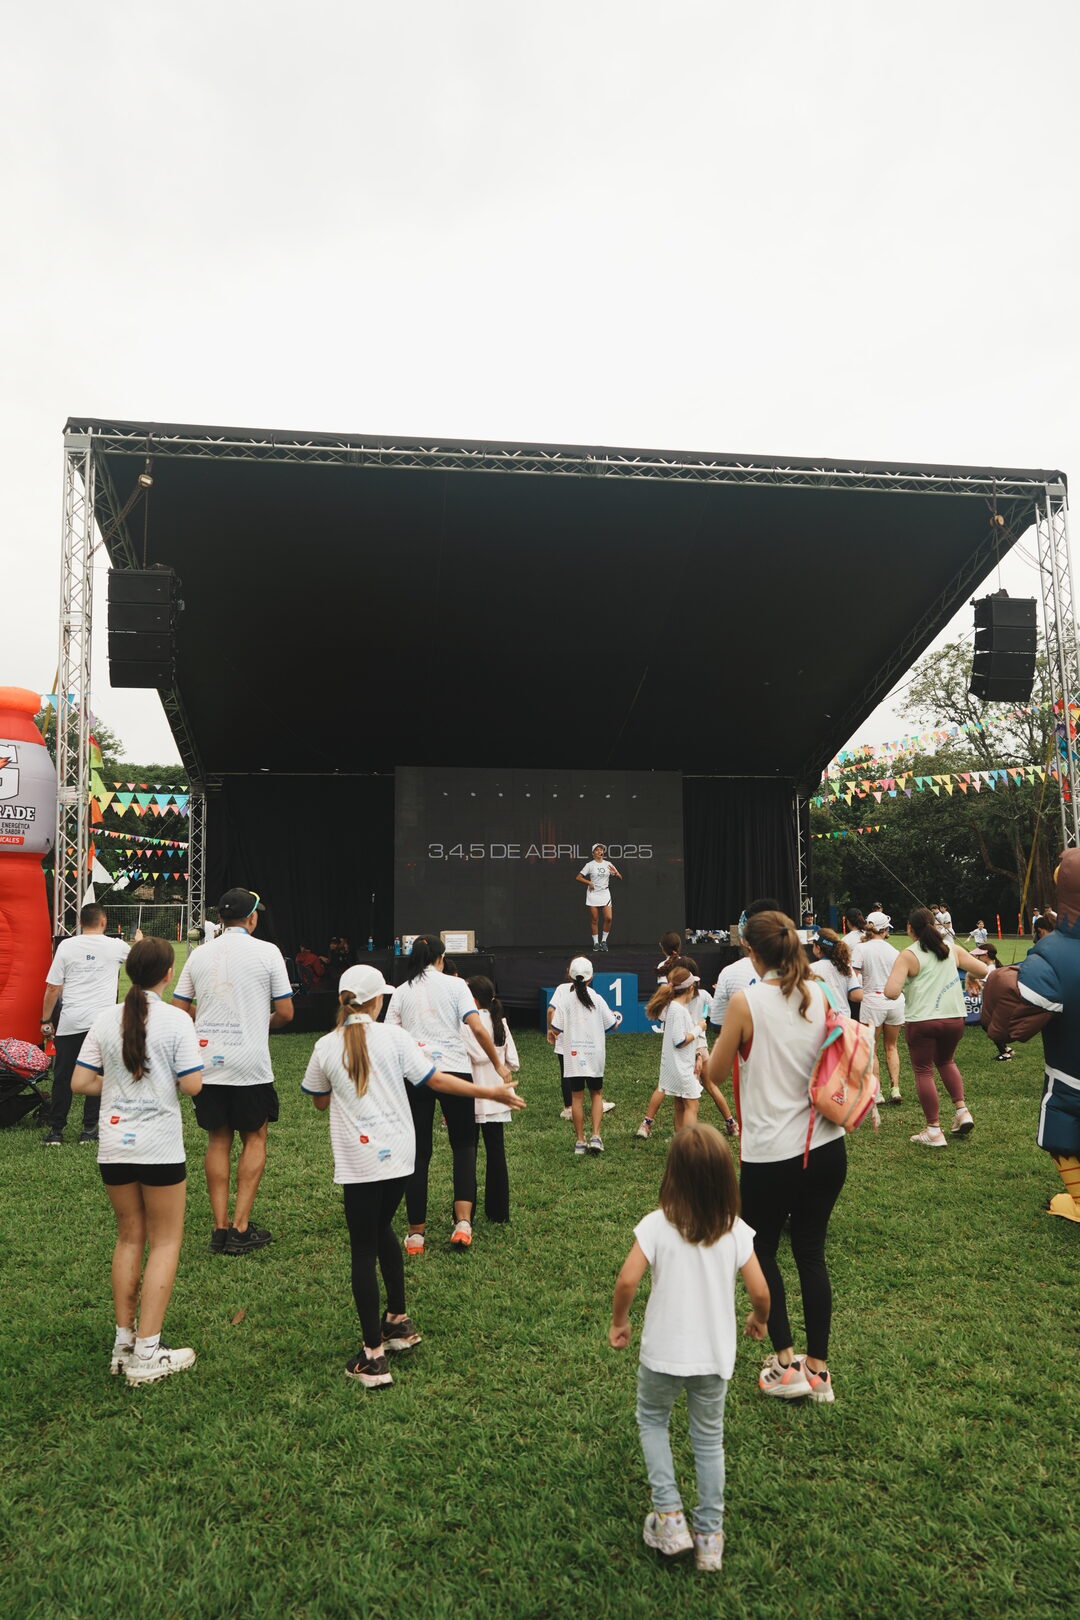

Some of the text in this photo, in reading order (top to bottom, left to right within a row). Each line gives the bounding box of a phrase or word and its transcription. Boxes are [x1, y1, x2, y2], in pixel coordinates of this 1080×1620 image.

[428, 843, 653, 861] 3,4,5 DE ABRIL 025
[609, 978, 622, 1006] 1
[964, 994, 982, 1006] egi
